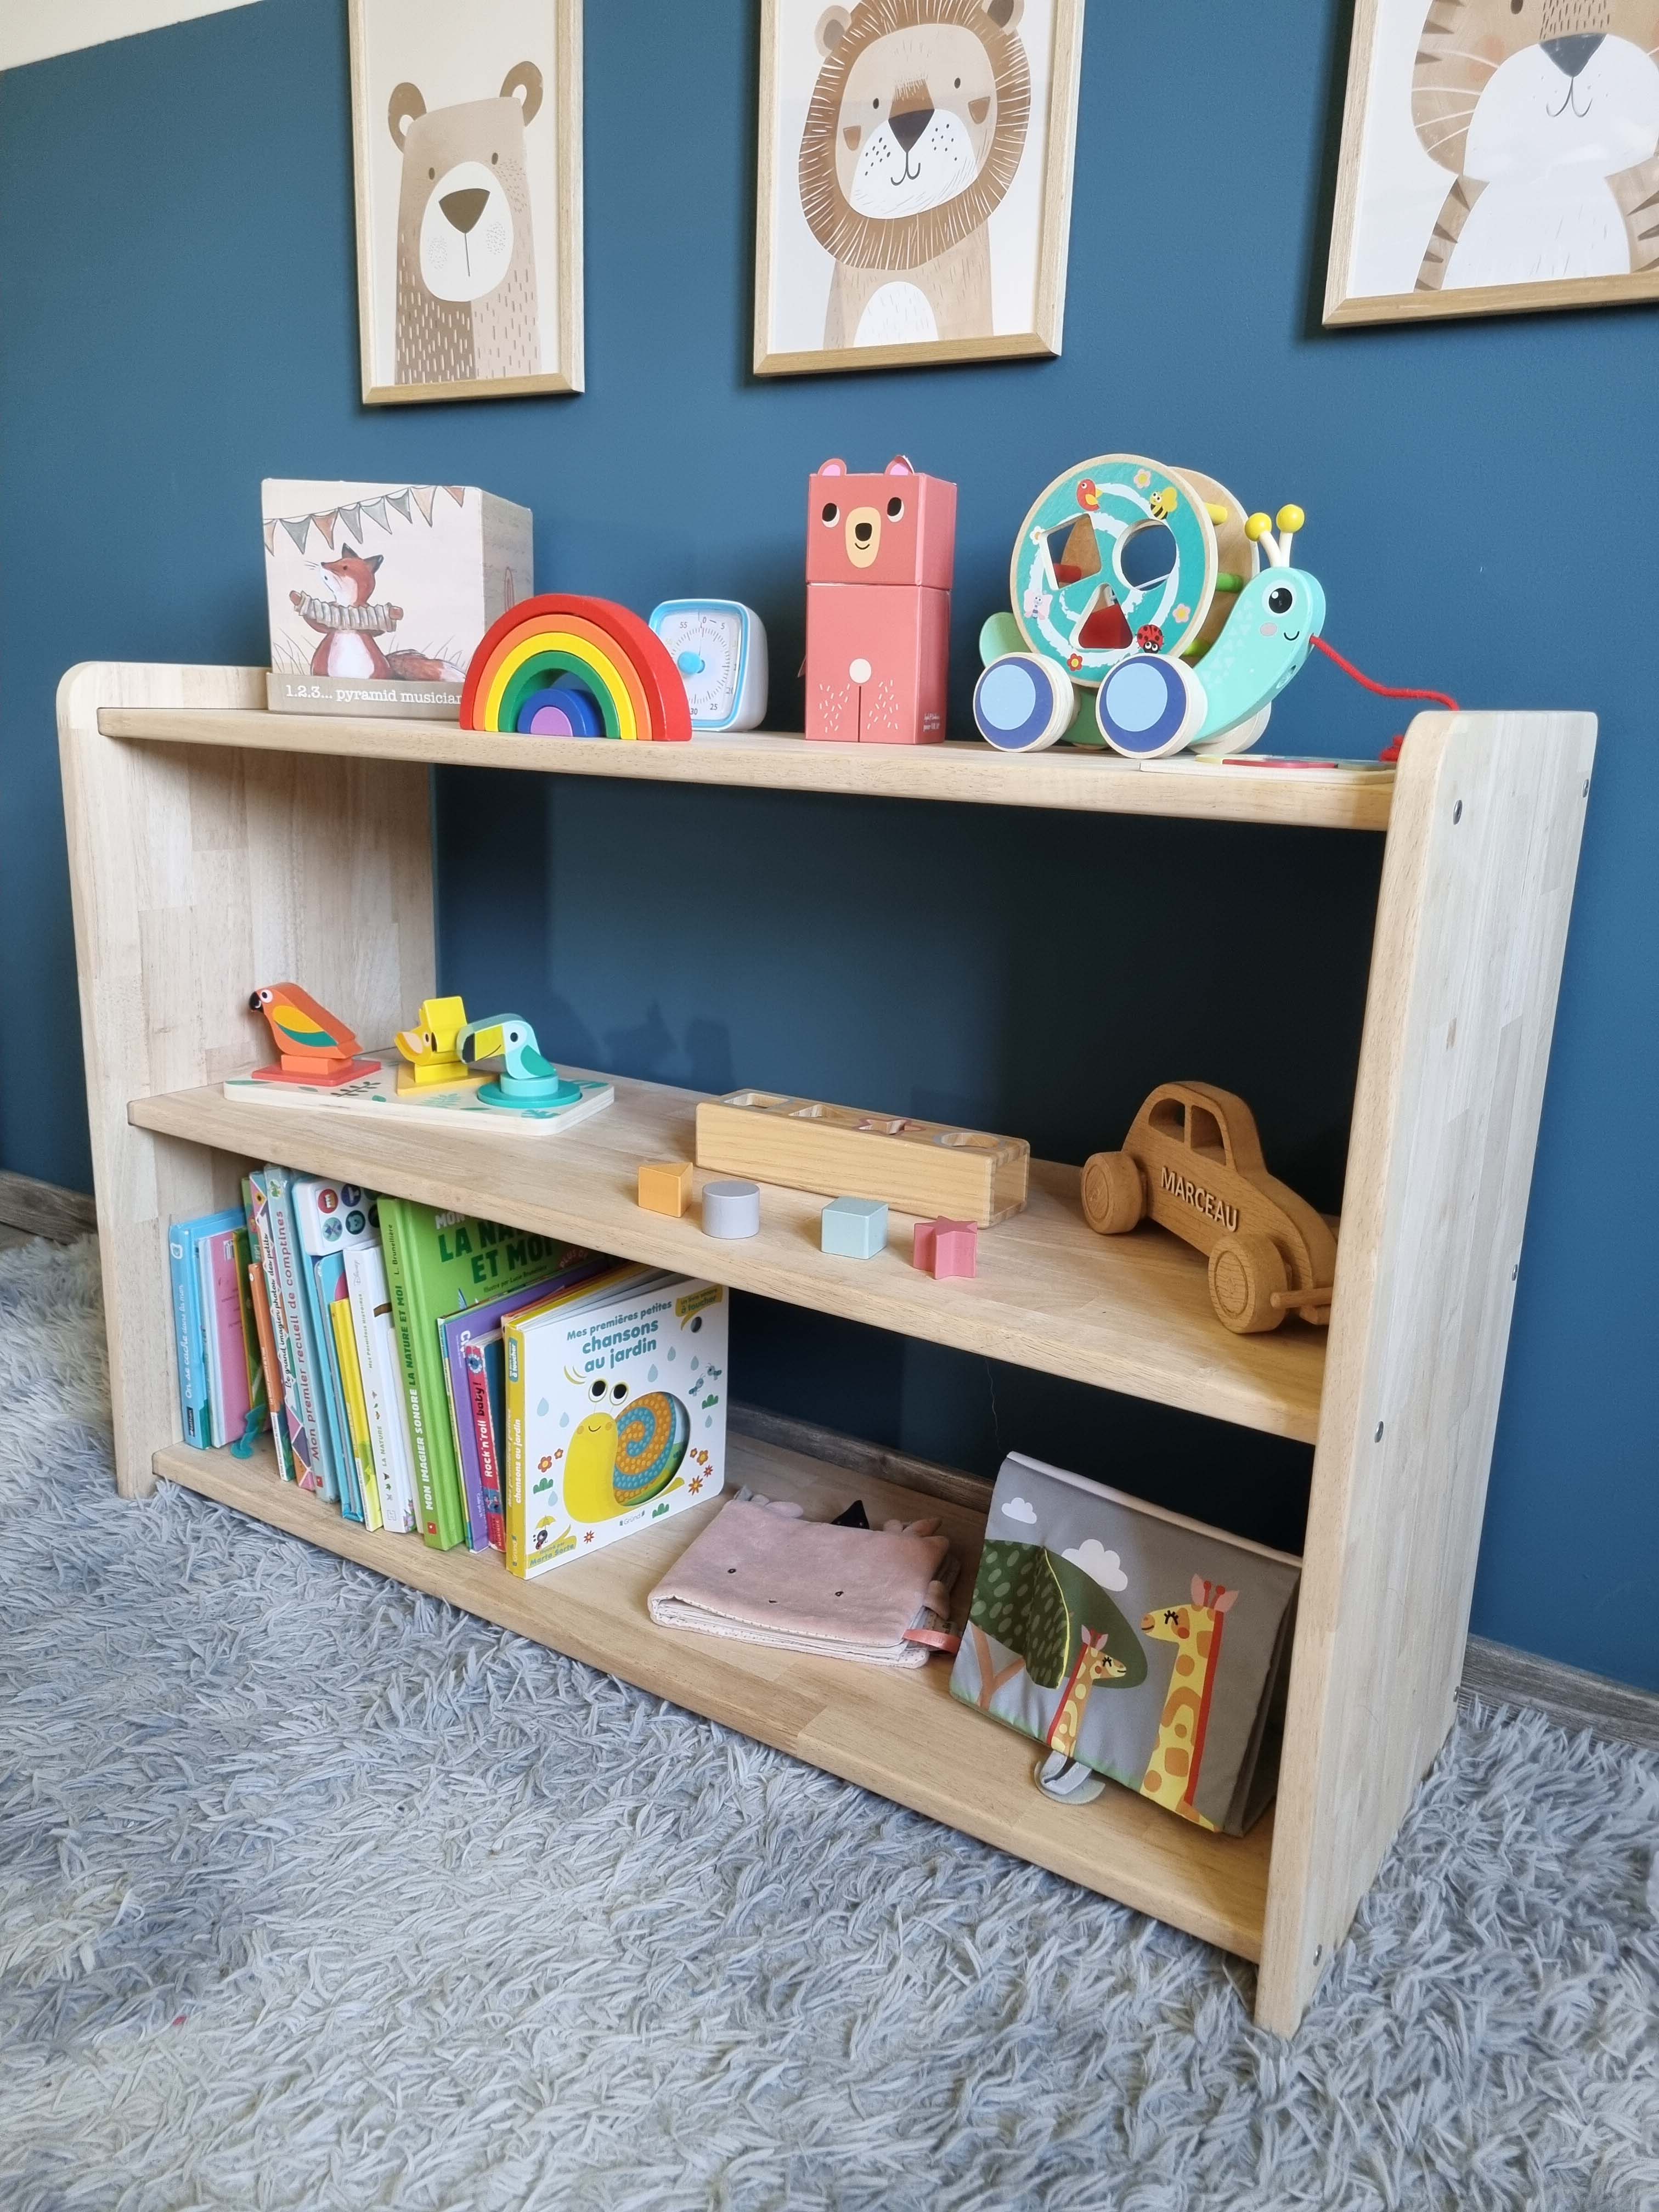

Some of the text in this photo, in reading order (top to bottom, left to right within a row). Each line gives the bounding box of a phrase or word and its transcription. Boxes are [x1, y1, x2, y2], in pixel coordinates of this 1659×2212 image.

[336, 689, 398, 703] pyramid
[1160, 1166, 1239, 1232] MARCEAU
[386, 1224, 399, 1265] Brunellière
[438, 1226, 472, 1262] LA
[506, 1235, 552, 1271] MOI
[470, 1249, 499, 1284] ET
[276, 1210, 320, 1461] Mon premier recueil de comptines
[567, 1300, 672, 1341] Mes premières petites
[582, 1319, 659, 1355] chansons
[584, 1338, 657, 1373] au jardin
[185, 1383, 193, 1399] On
[395, 1285, 434, 1511] MON IMAGIER SONORE LA NATURE ET MOI
[377, 1426, 387, 1467] LA NATURE
[514, 1419, 523, 1504] chansons au jardin
